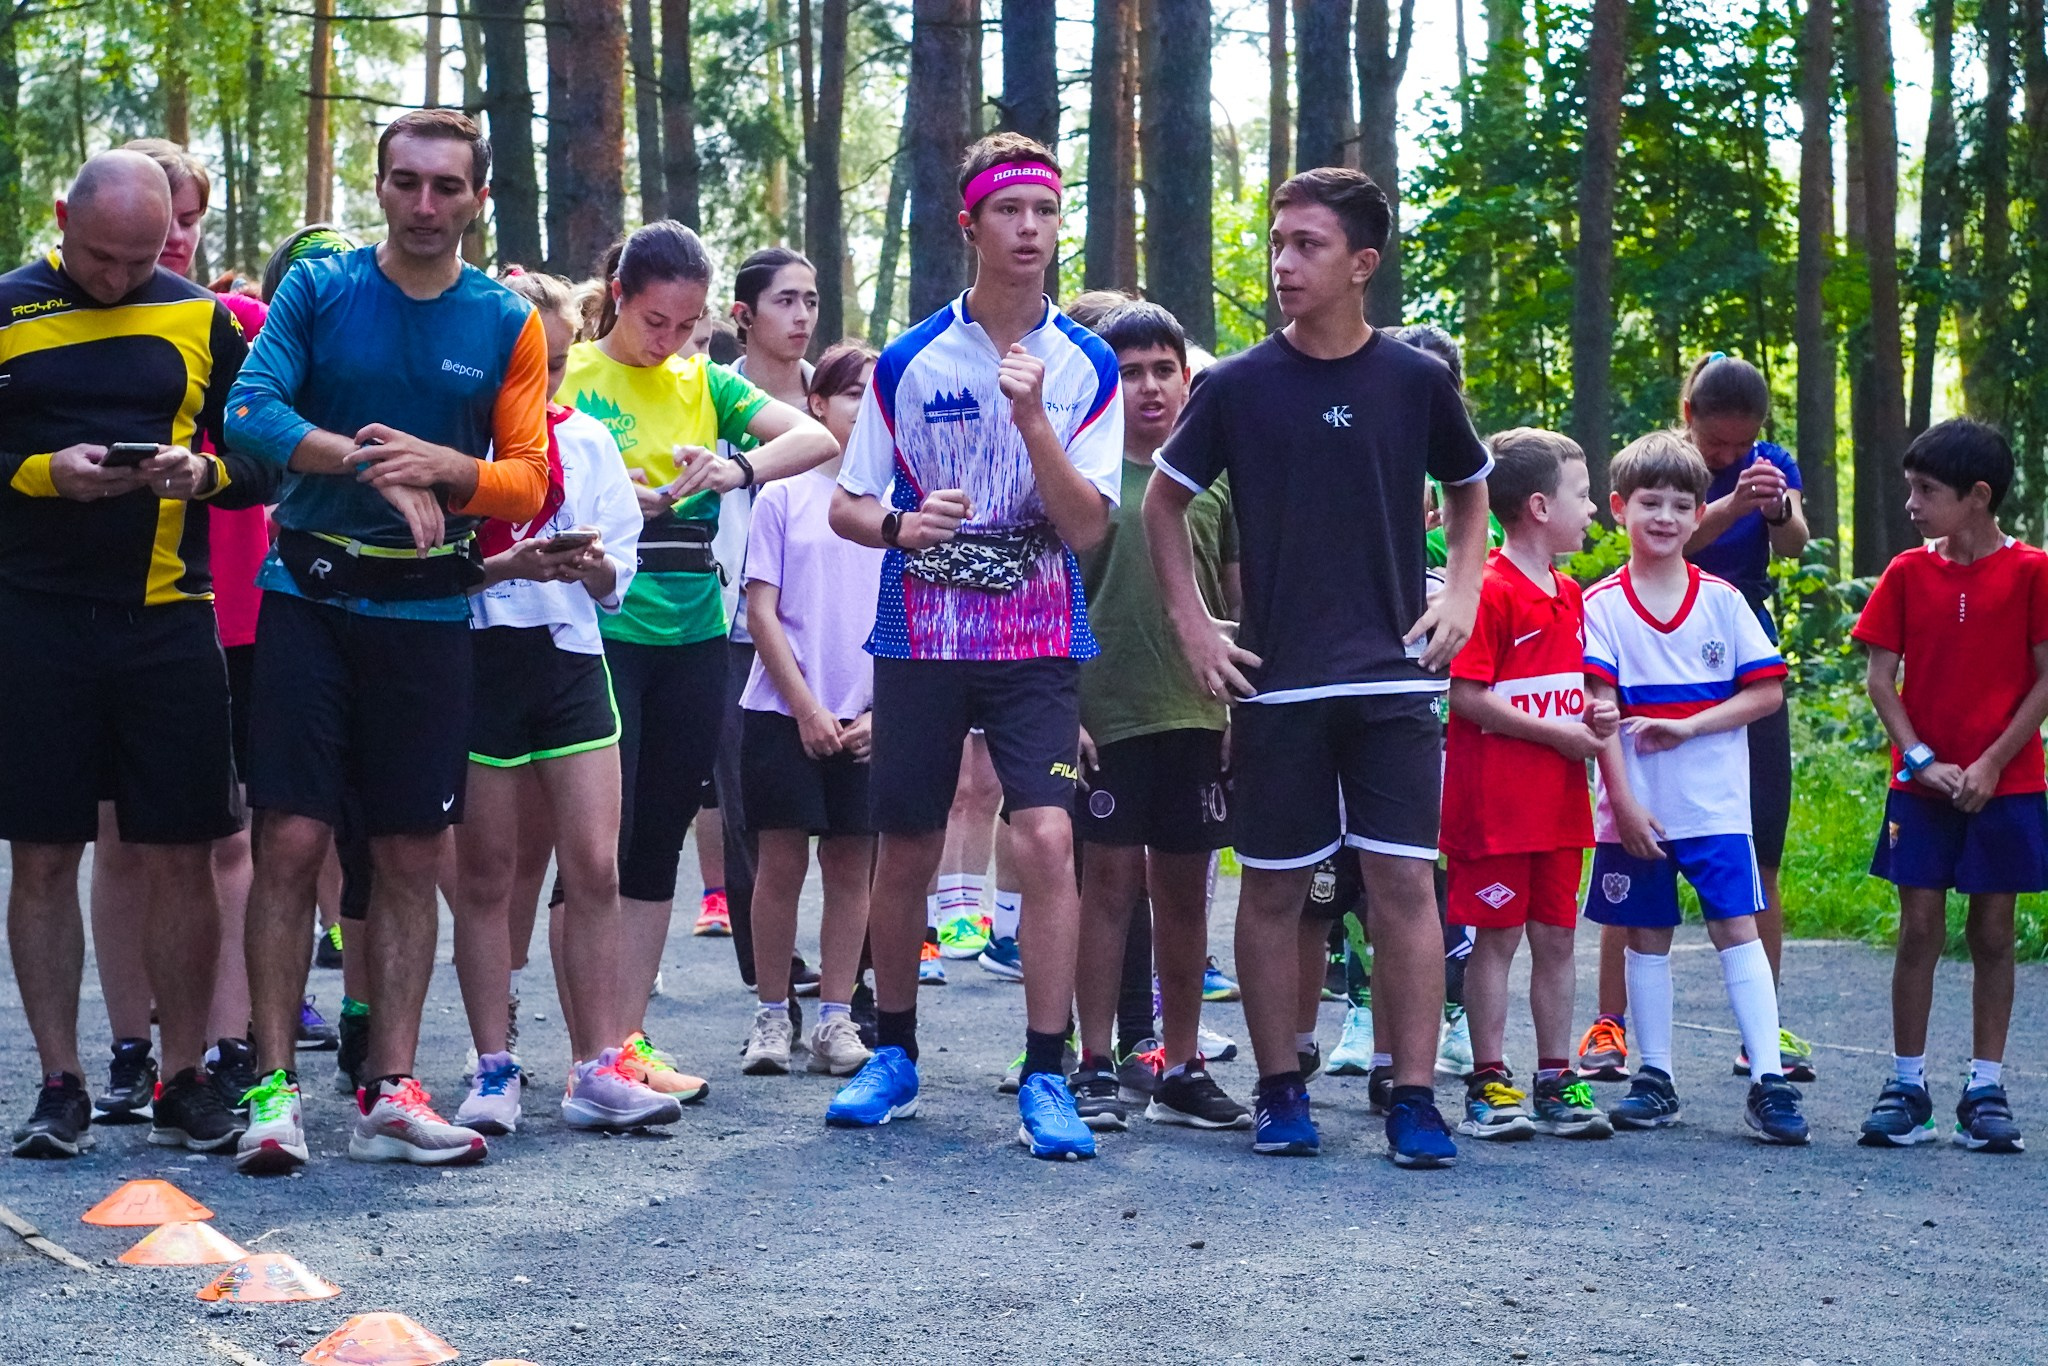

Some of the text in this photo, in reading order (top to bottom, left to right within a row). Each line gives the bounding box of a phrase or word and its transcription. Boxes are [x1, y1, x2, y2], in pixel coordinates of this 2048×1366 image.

[993, 167, 1052, 182] noname
[11, 297, 72, 317] ROYAL
[1050, 762, 1078, 780] FILA
